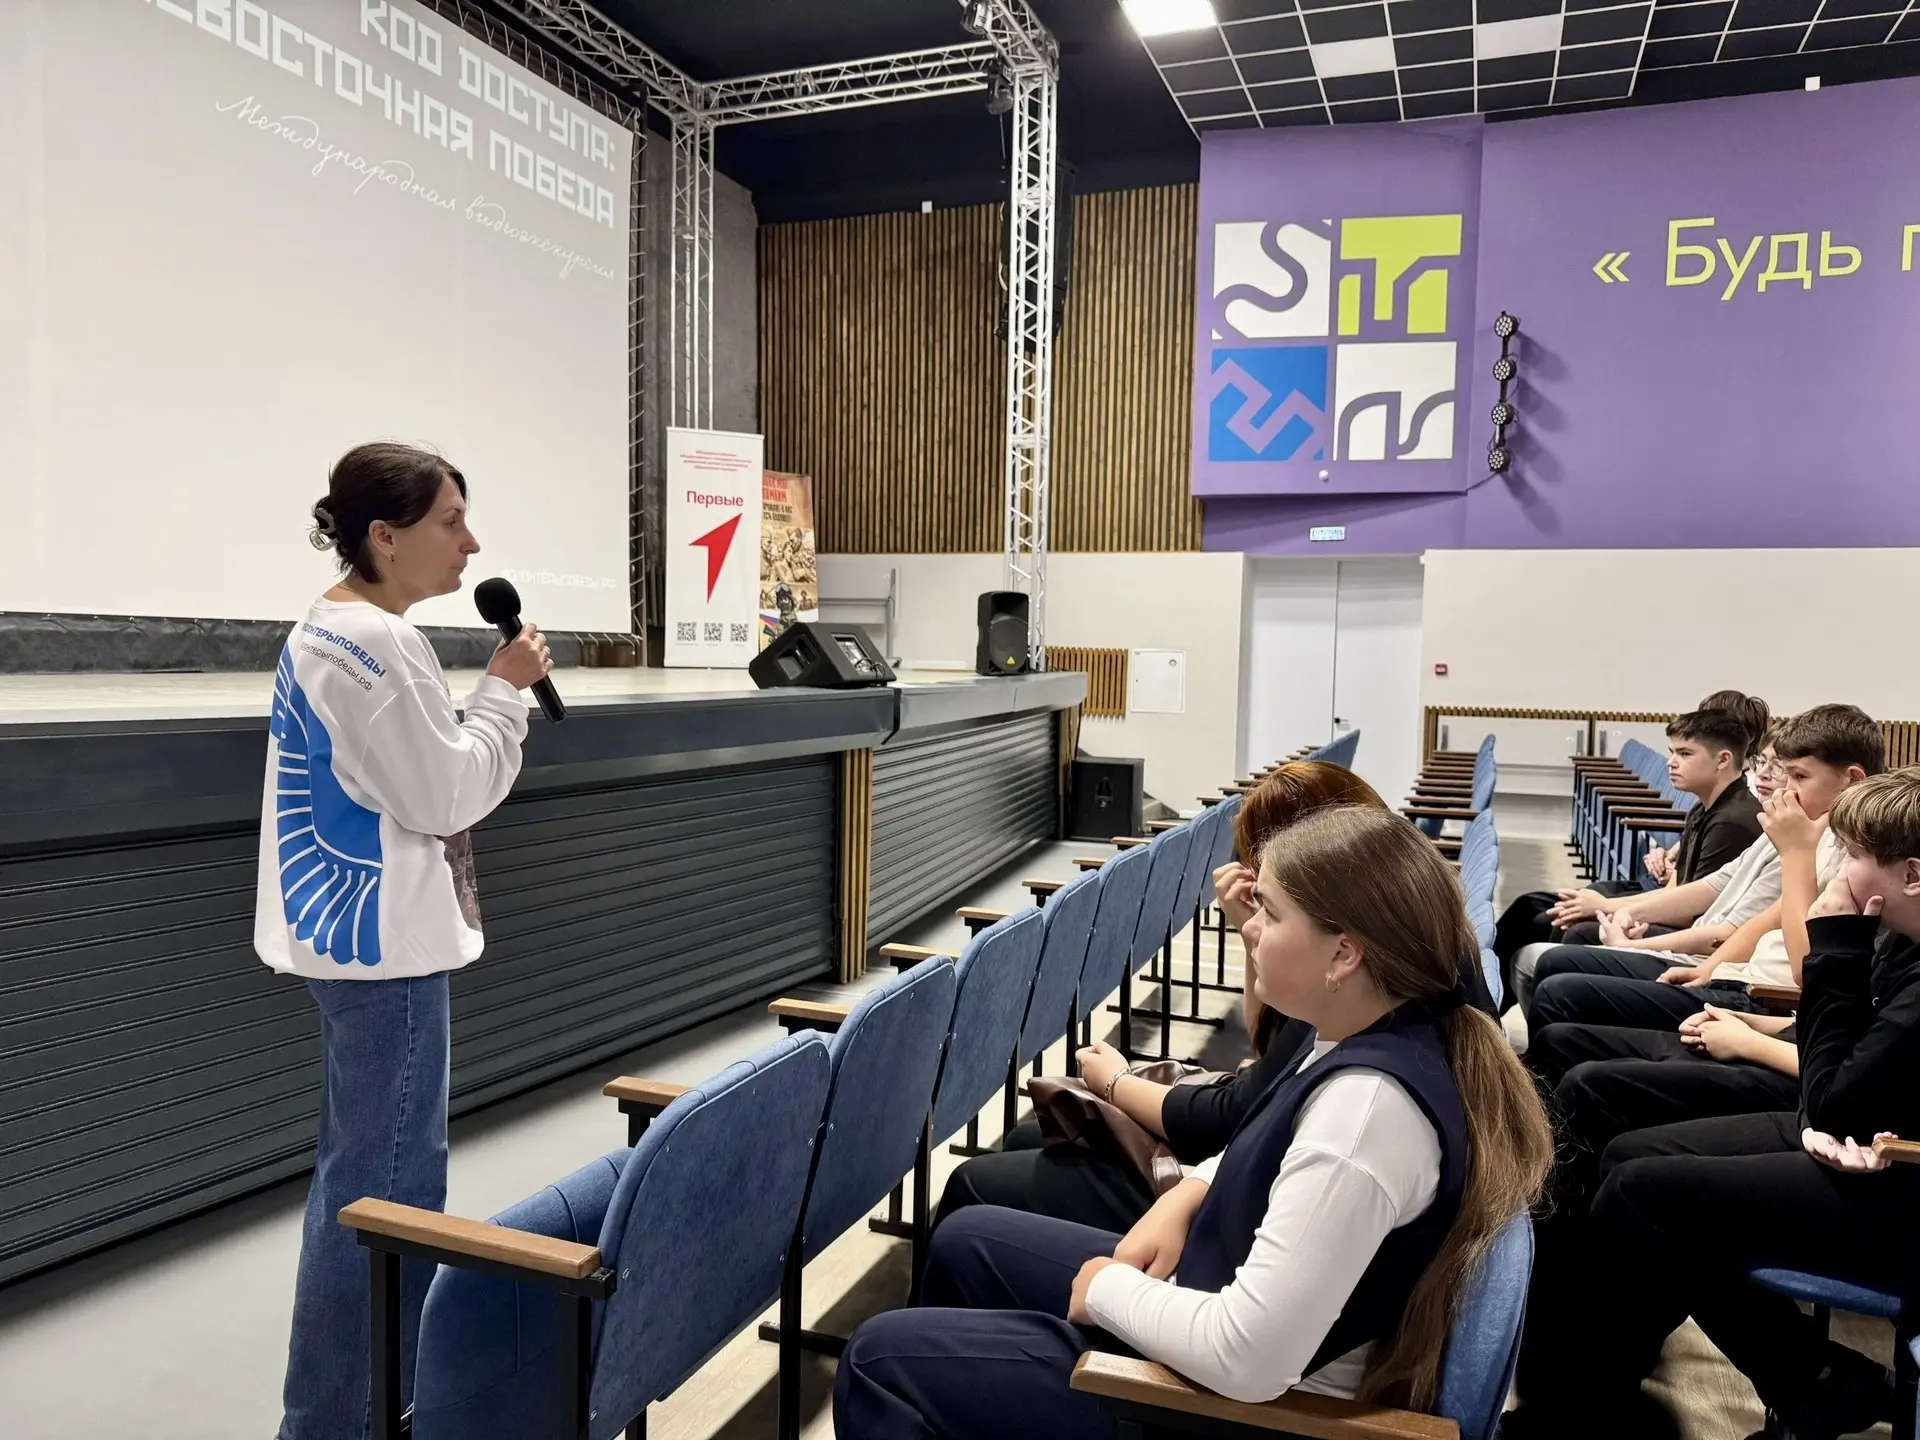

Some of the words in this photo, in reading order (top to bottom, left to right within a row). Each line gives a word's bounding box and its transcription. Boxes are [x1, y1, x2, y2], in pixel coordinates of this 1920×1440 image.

[360, 0, 443, 77] КОД
[458, 46, 616, 171] ДОСТУПА:
[214, 94, 457, 213] Международная
[489, 129, 615, 229] ПОБЕДА
[1664, 217, 1862, 302] Будь
[686, 490, 744, 508] Первые
